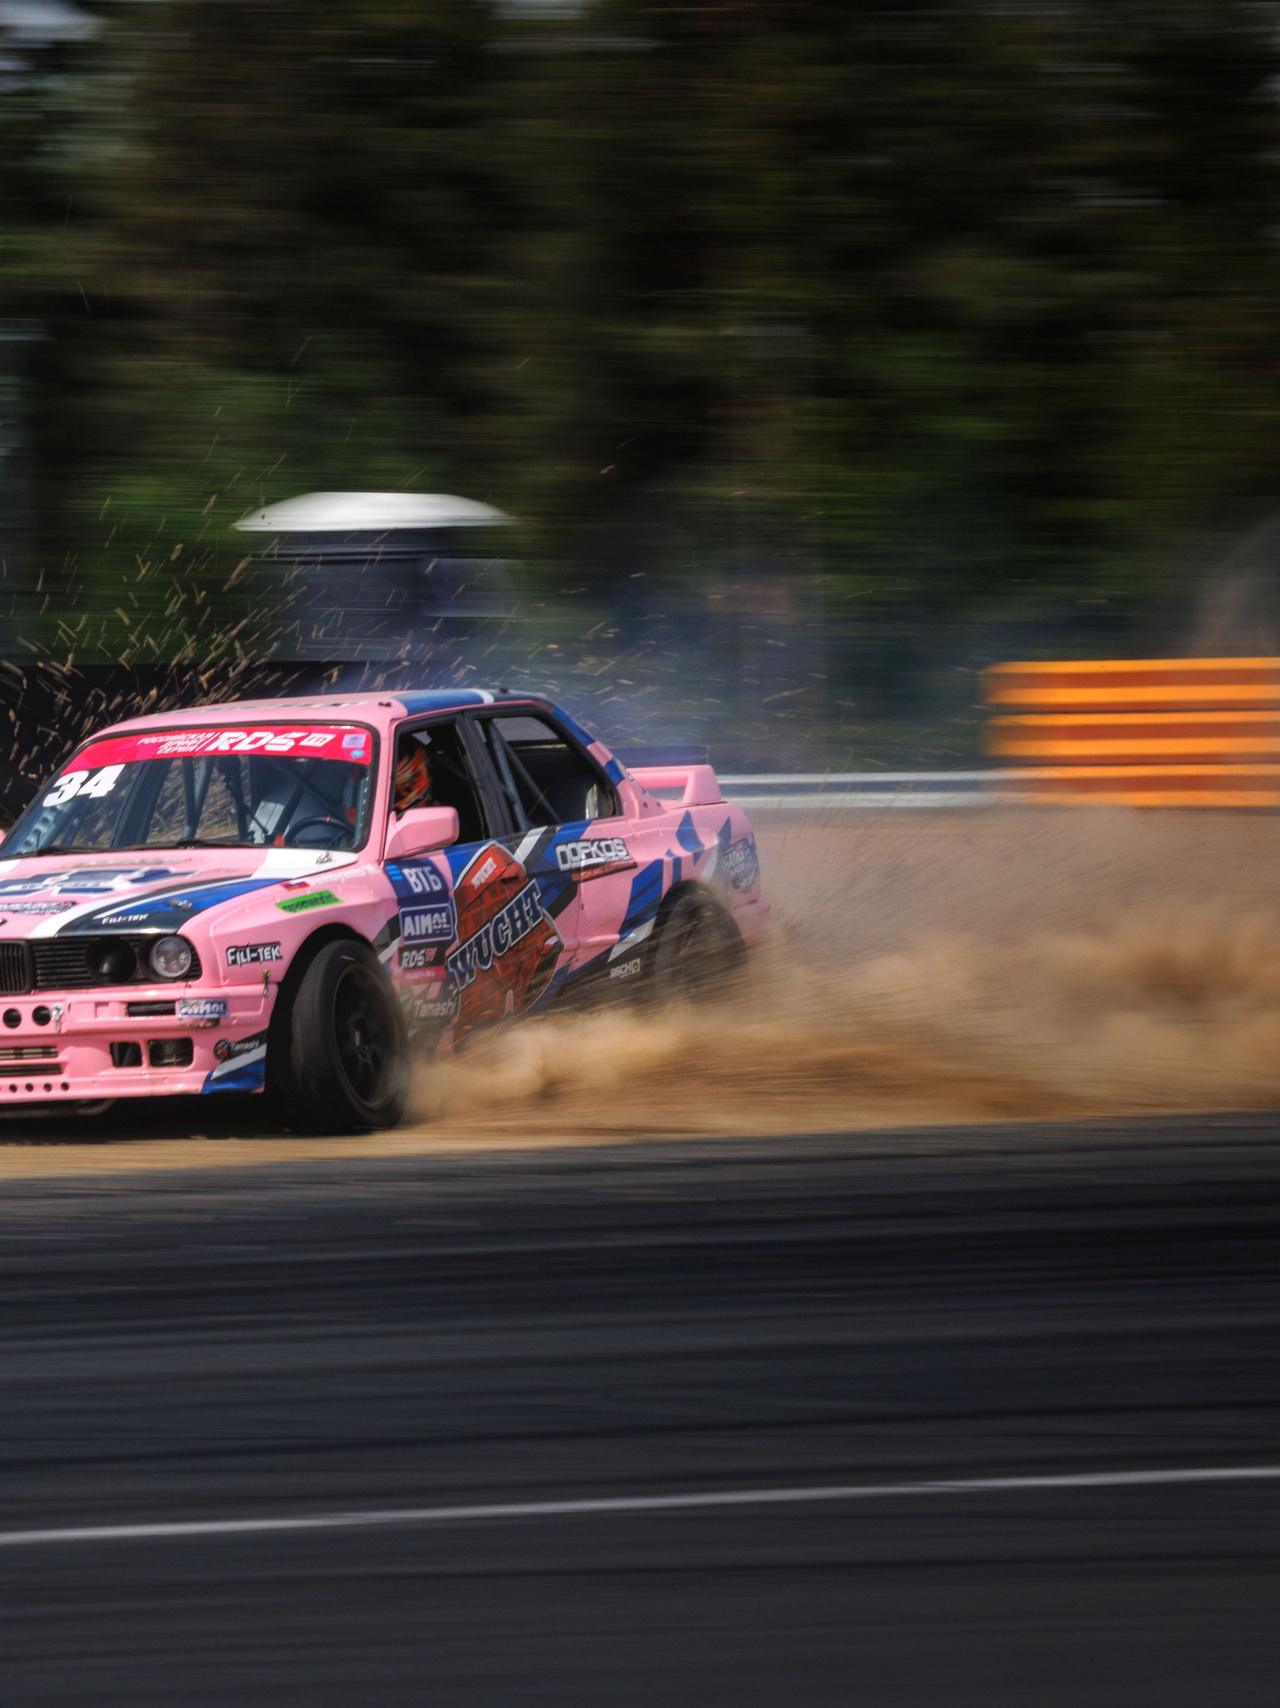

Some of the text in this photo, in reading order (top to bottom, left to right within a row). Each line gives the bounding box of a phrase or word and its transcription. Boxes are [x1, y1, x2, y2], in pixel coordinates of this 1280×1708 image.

[204, 732, 308, 751] RDS
[42, 763, 126, 807] 34
[402, 866, 443, 893] ВТБ
[404, 912, 451, 936] AIMOL
[448, 878, 544, 991] WUCHT
[227, 944, 280, 965] FILI-TEK
